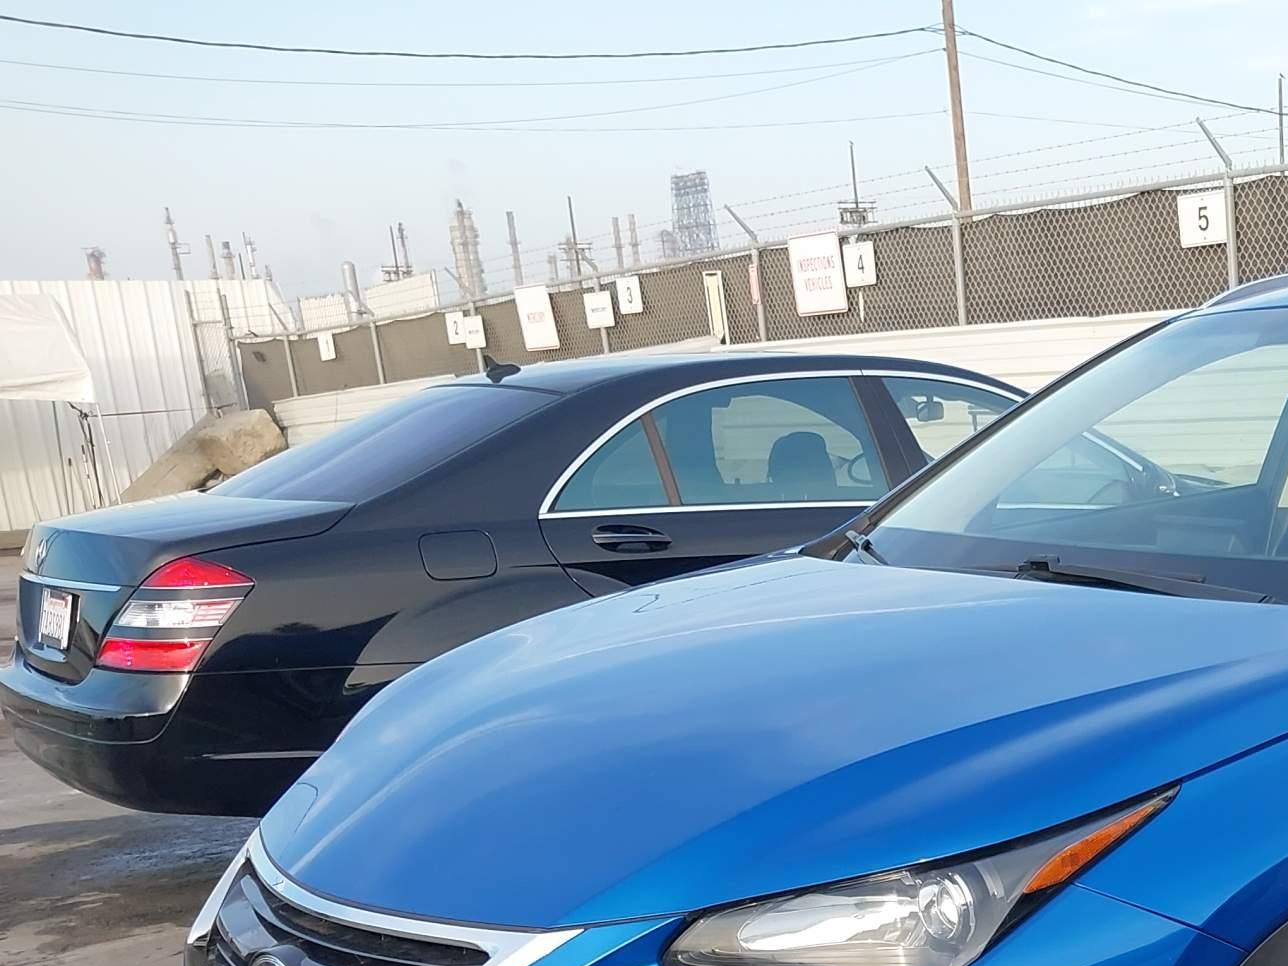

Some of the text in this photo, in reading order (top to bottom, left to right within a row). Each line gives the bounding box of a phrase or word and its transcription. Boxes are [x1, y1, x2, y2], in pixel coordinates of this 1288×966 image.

[1198, 206, 1209, 231] 5
[857, 254, 865, 274] 4
[626, 286, 633, 304] 3
[453, 320, 460, 336] 2
